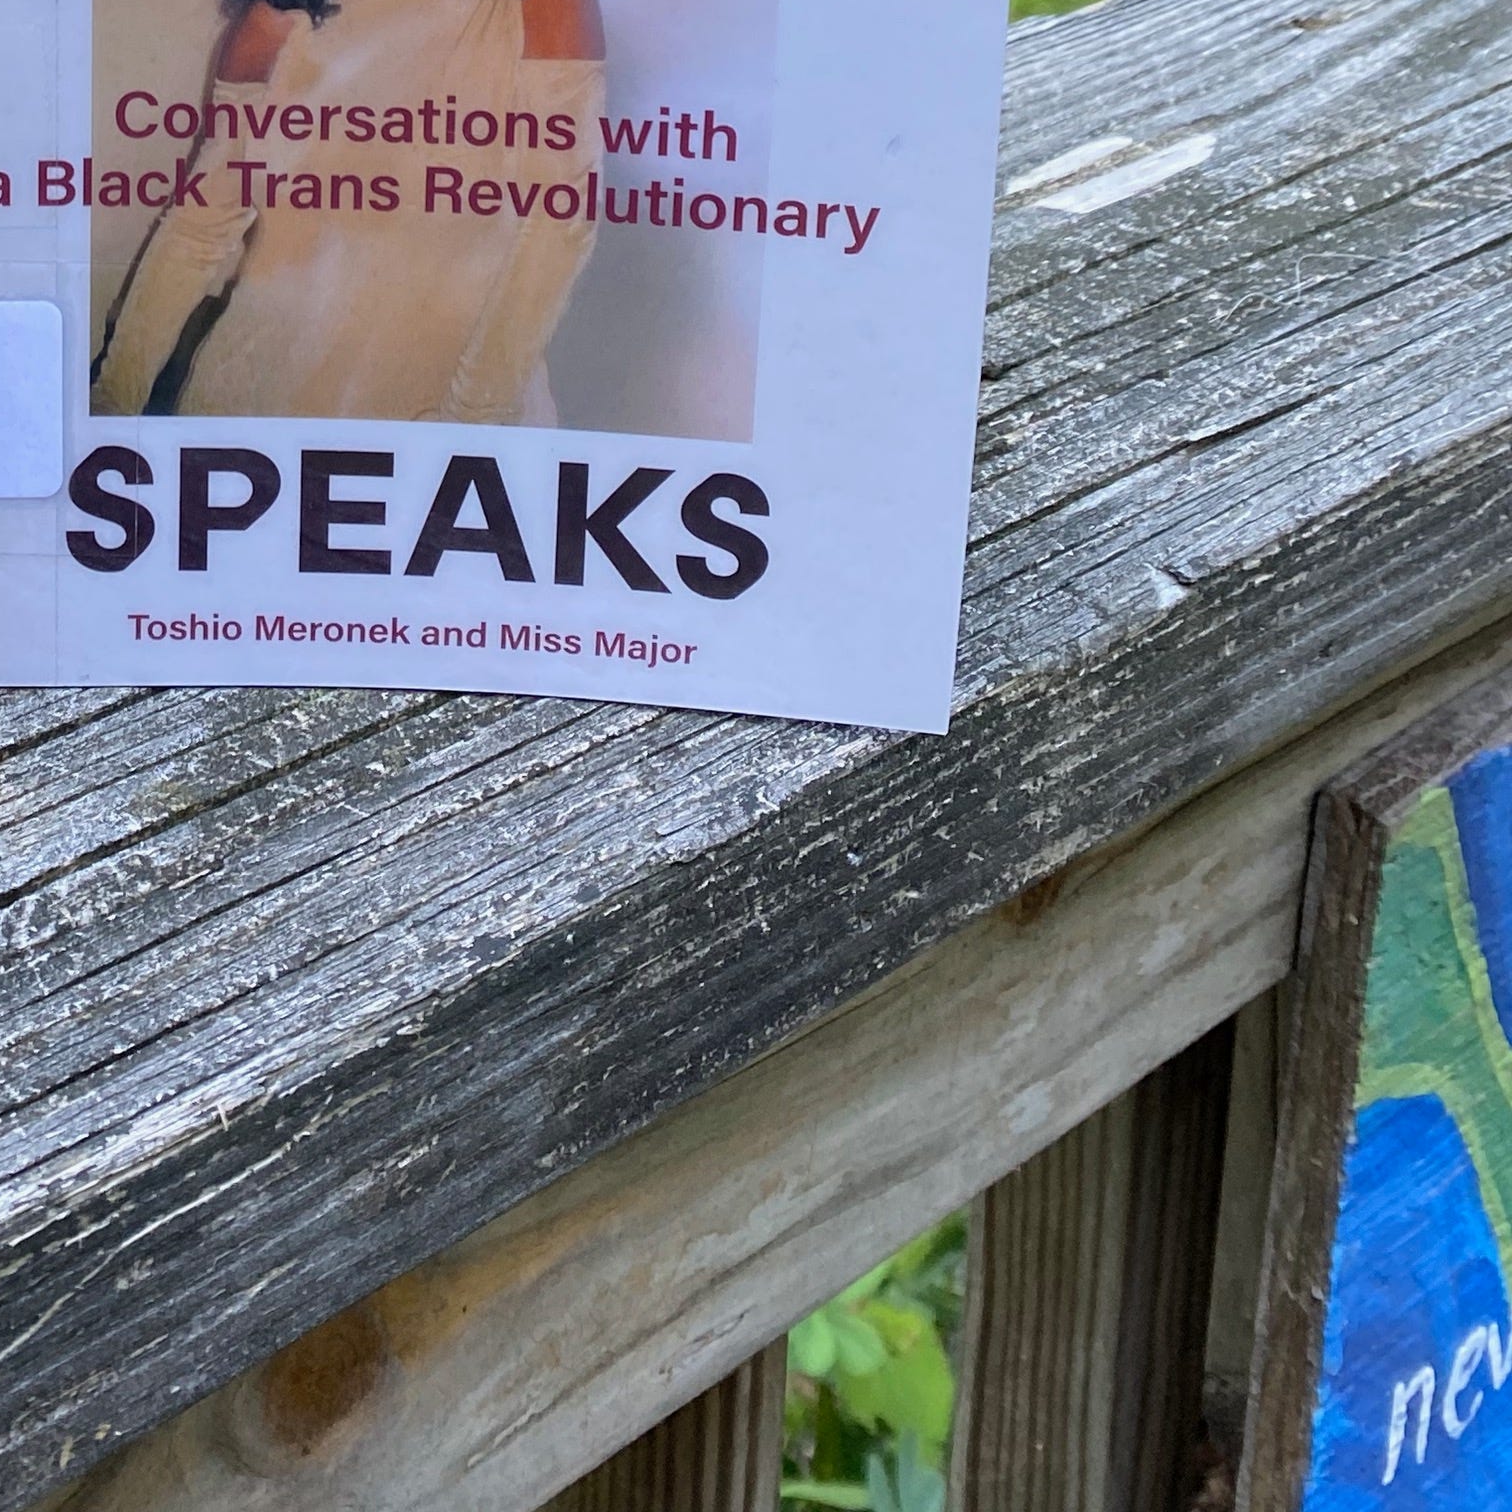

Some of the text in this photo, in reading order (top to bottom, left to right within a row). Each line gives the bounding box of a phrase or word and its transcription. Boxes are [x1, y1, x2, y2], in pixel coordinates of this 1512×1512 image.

[115, 90, 738, 162] Conversations with
[37, 157, 209, 208] Black
[226, 160, 401, 212] Trans
[424, 165, 881, 255] Revolutionary
[65, 445, 771, 601] SPEAKS
[127, 613, 699, 668] Toshio Meronek and Miss Major
